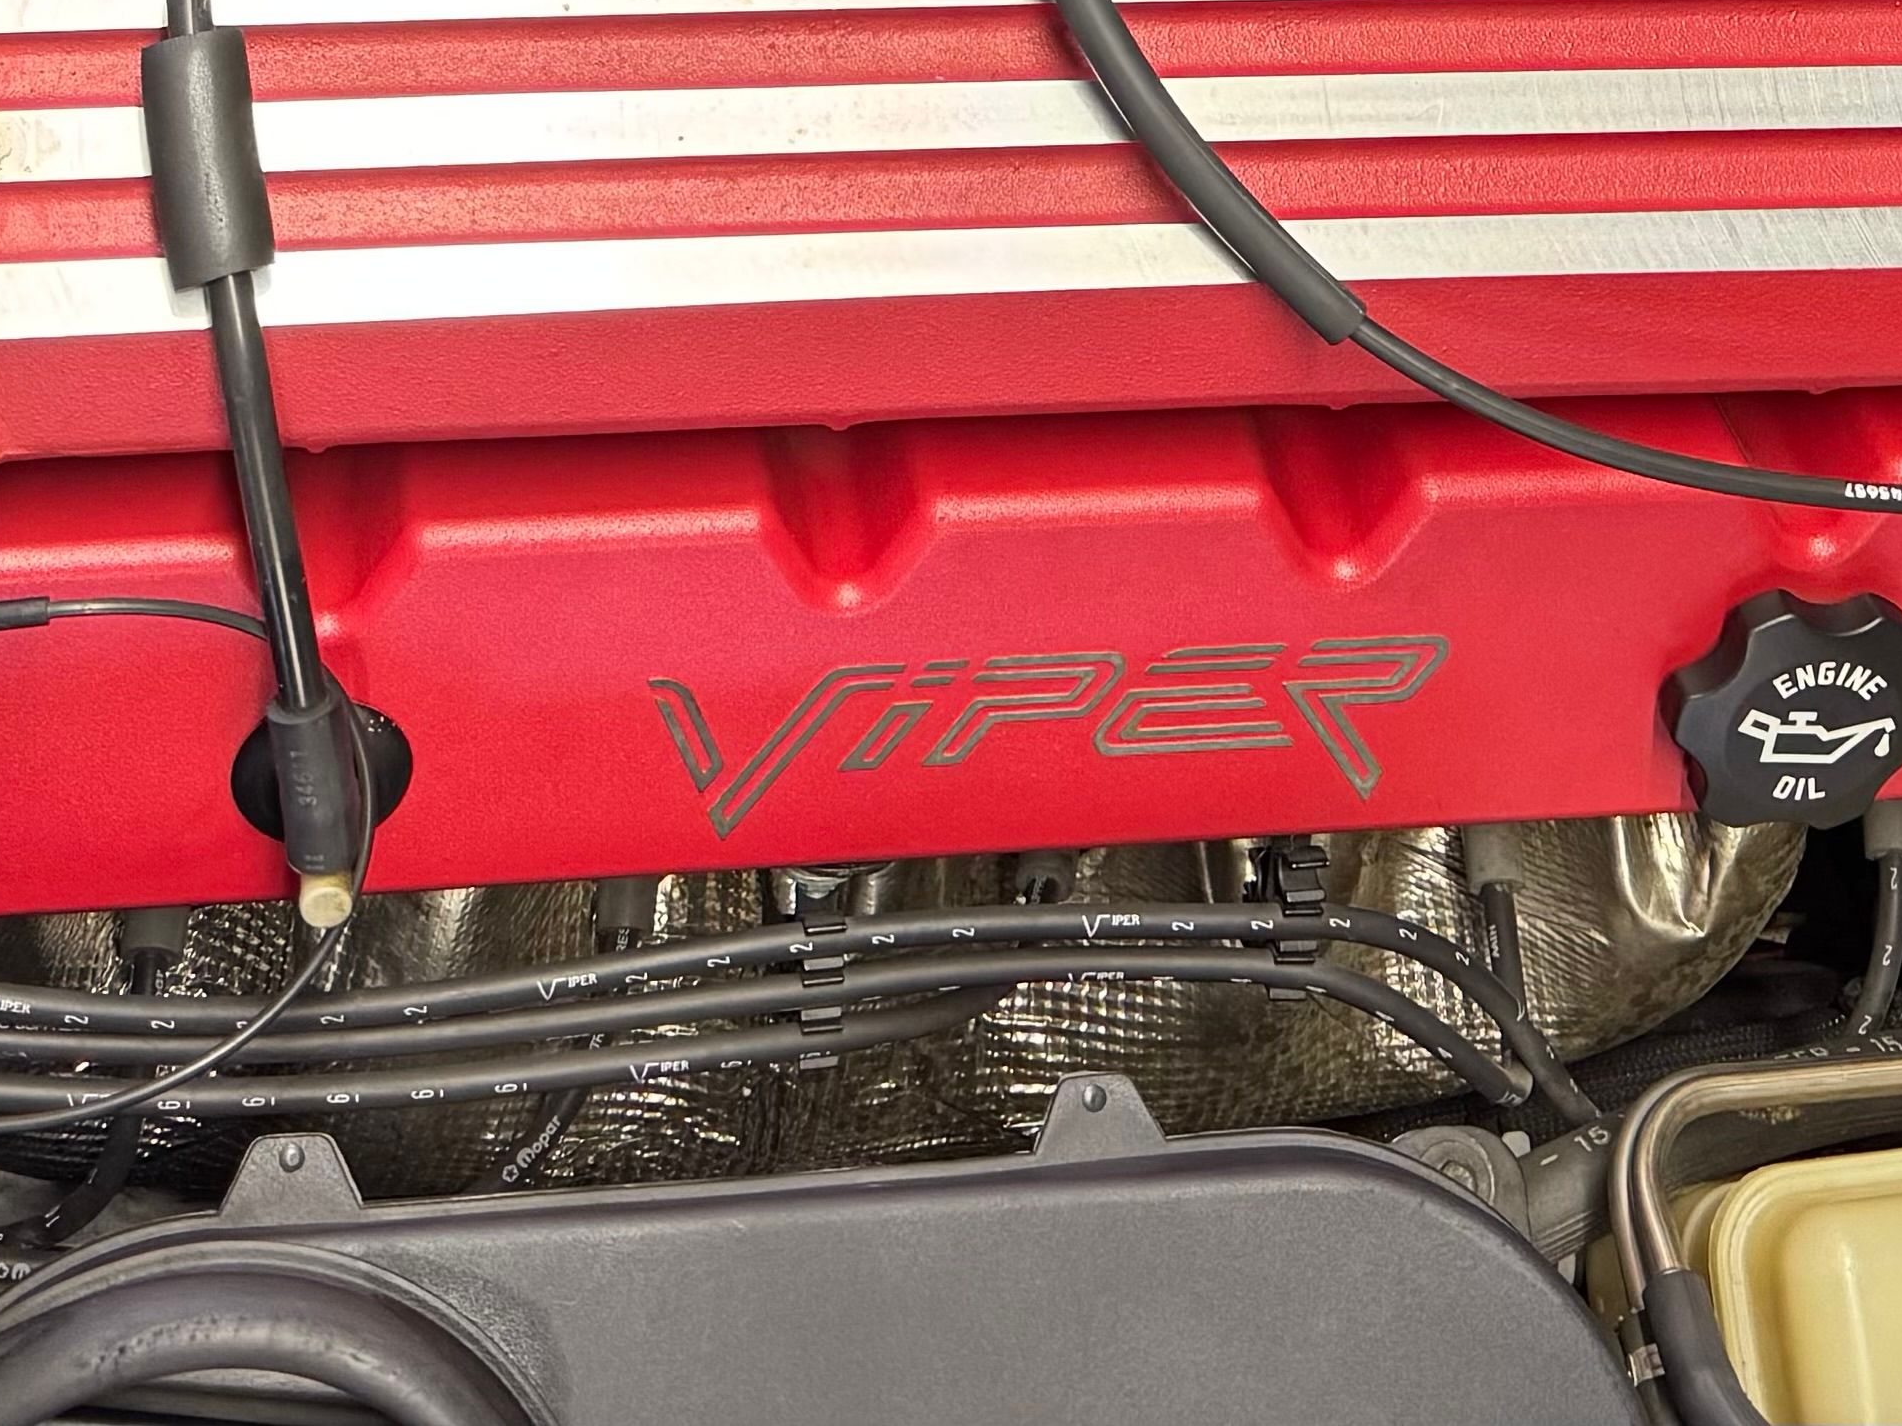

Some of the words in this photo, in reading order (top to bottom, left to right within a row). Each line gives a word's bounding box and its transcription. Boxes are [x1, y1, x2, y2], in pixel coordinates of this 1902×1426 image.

[1772, 661, 1888, 701] ENGINE
[1772, 774, 1827, 801] OIL
[536, 972, 598, 1001] VIPER
[1081, 912, 1141, 938] VIPER
